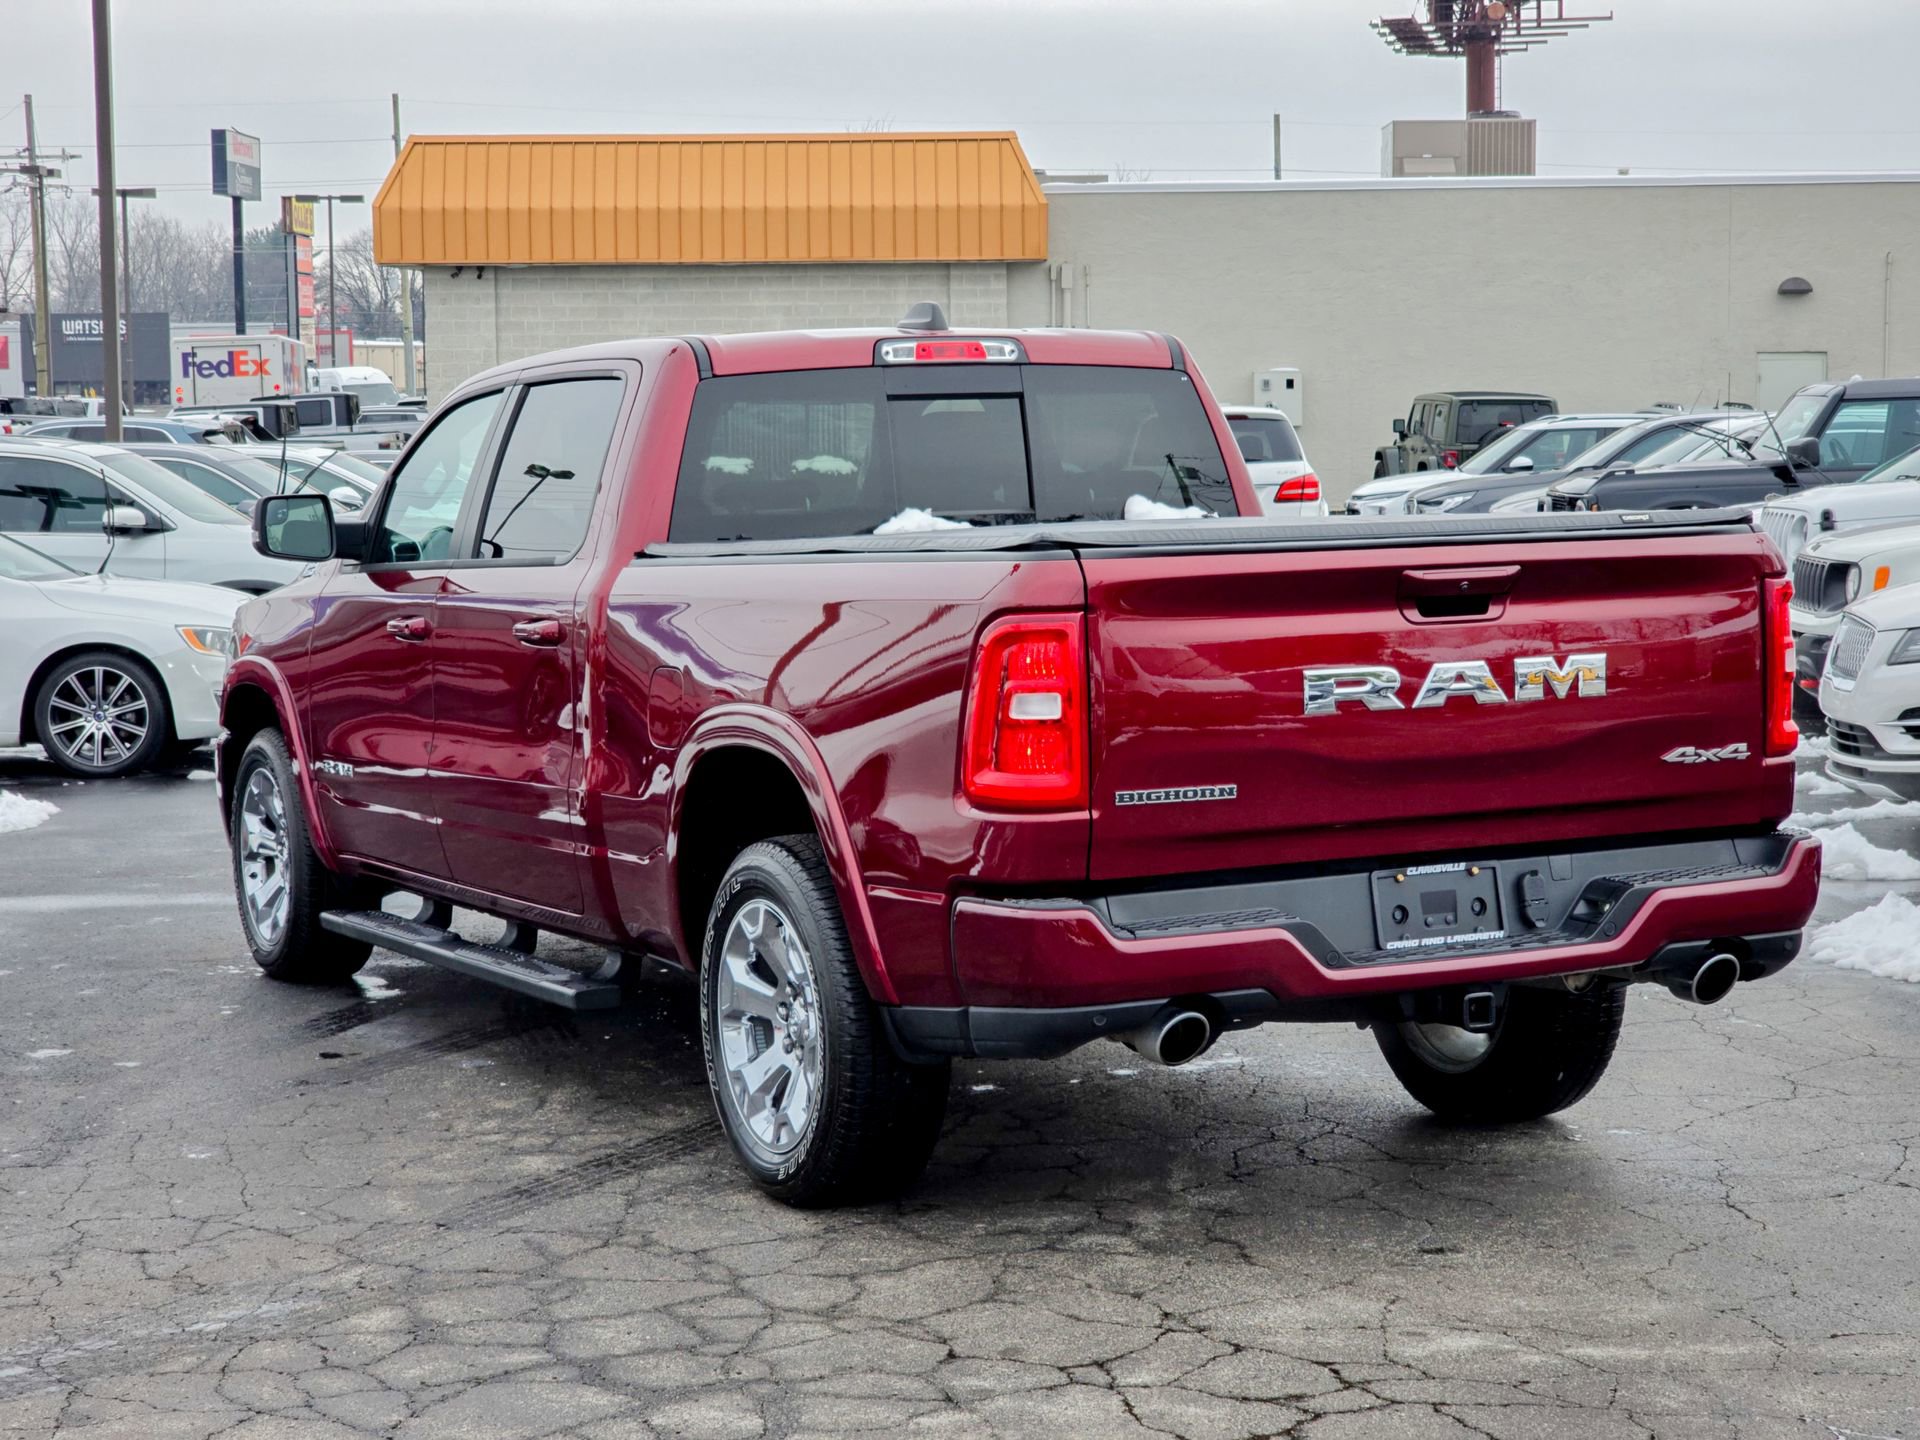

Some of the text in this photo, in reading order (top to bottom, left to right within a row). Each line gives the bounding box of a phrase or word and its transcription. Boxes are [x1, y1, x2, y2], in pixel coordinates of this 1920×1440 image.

[181, 350, 272, 379] FedEx
[1303, 653, 1607, 715] RAM
[1115, 784, 1238, 806] BIGHORN
[1406, 862, 1467, 876] CLARKSVILLE
[1386, 930, 1505, 950] CRAIG AND LANDRETH
